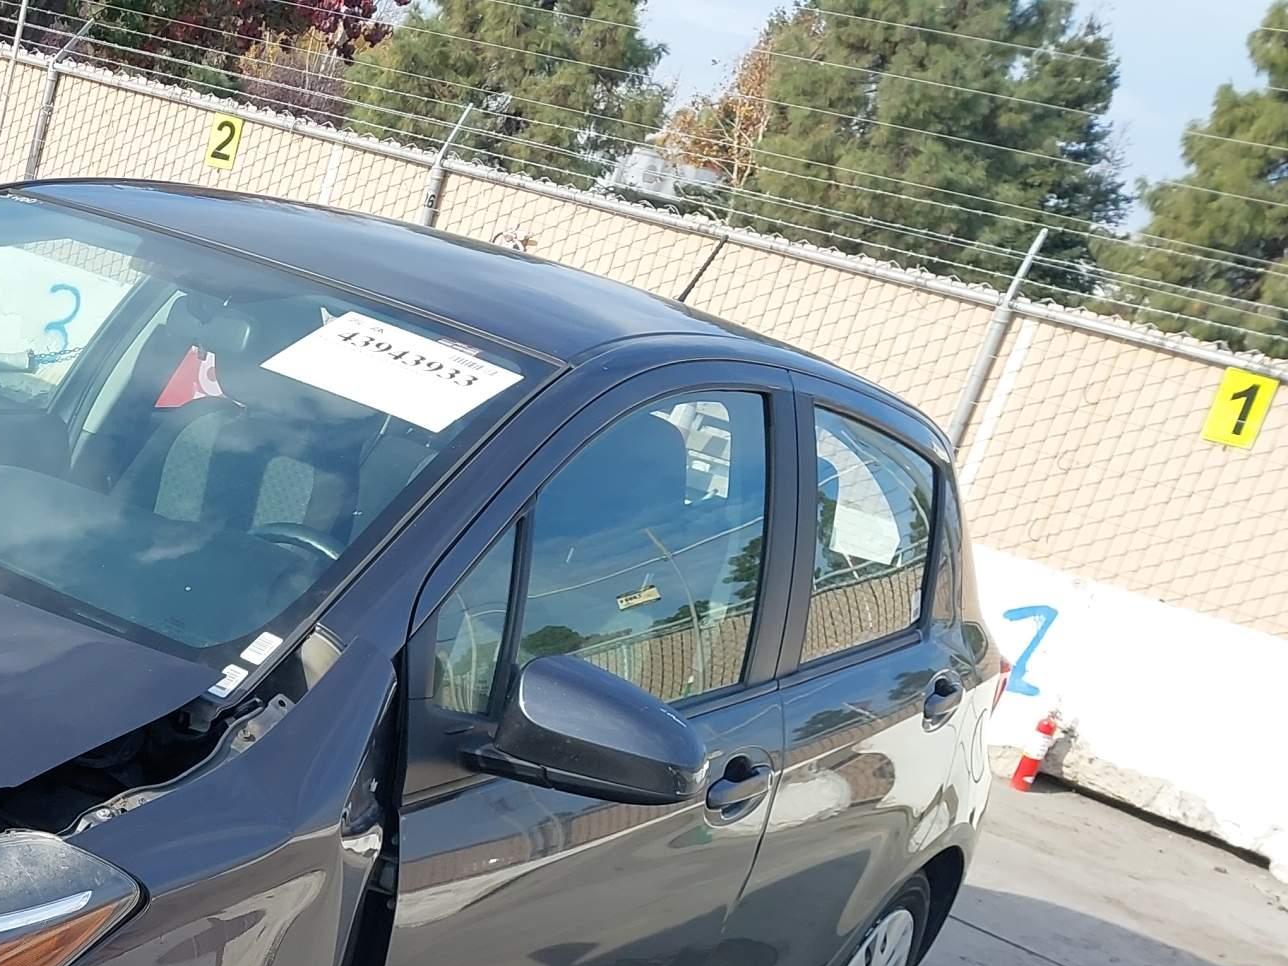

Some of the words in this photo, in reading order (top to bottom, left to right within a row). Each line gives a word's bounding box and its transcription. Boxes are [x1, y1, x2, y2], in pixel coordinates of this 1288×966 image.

[211, 120, 236, 161] 2
[337, 330, 479, 387] 43943933
[1230, 383, 1261, 436] 1
